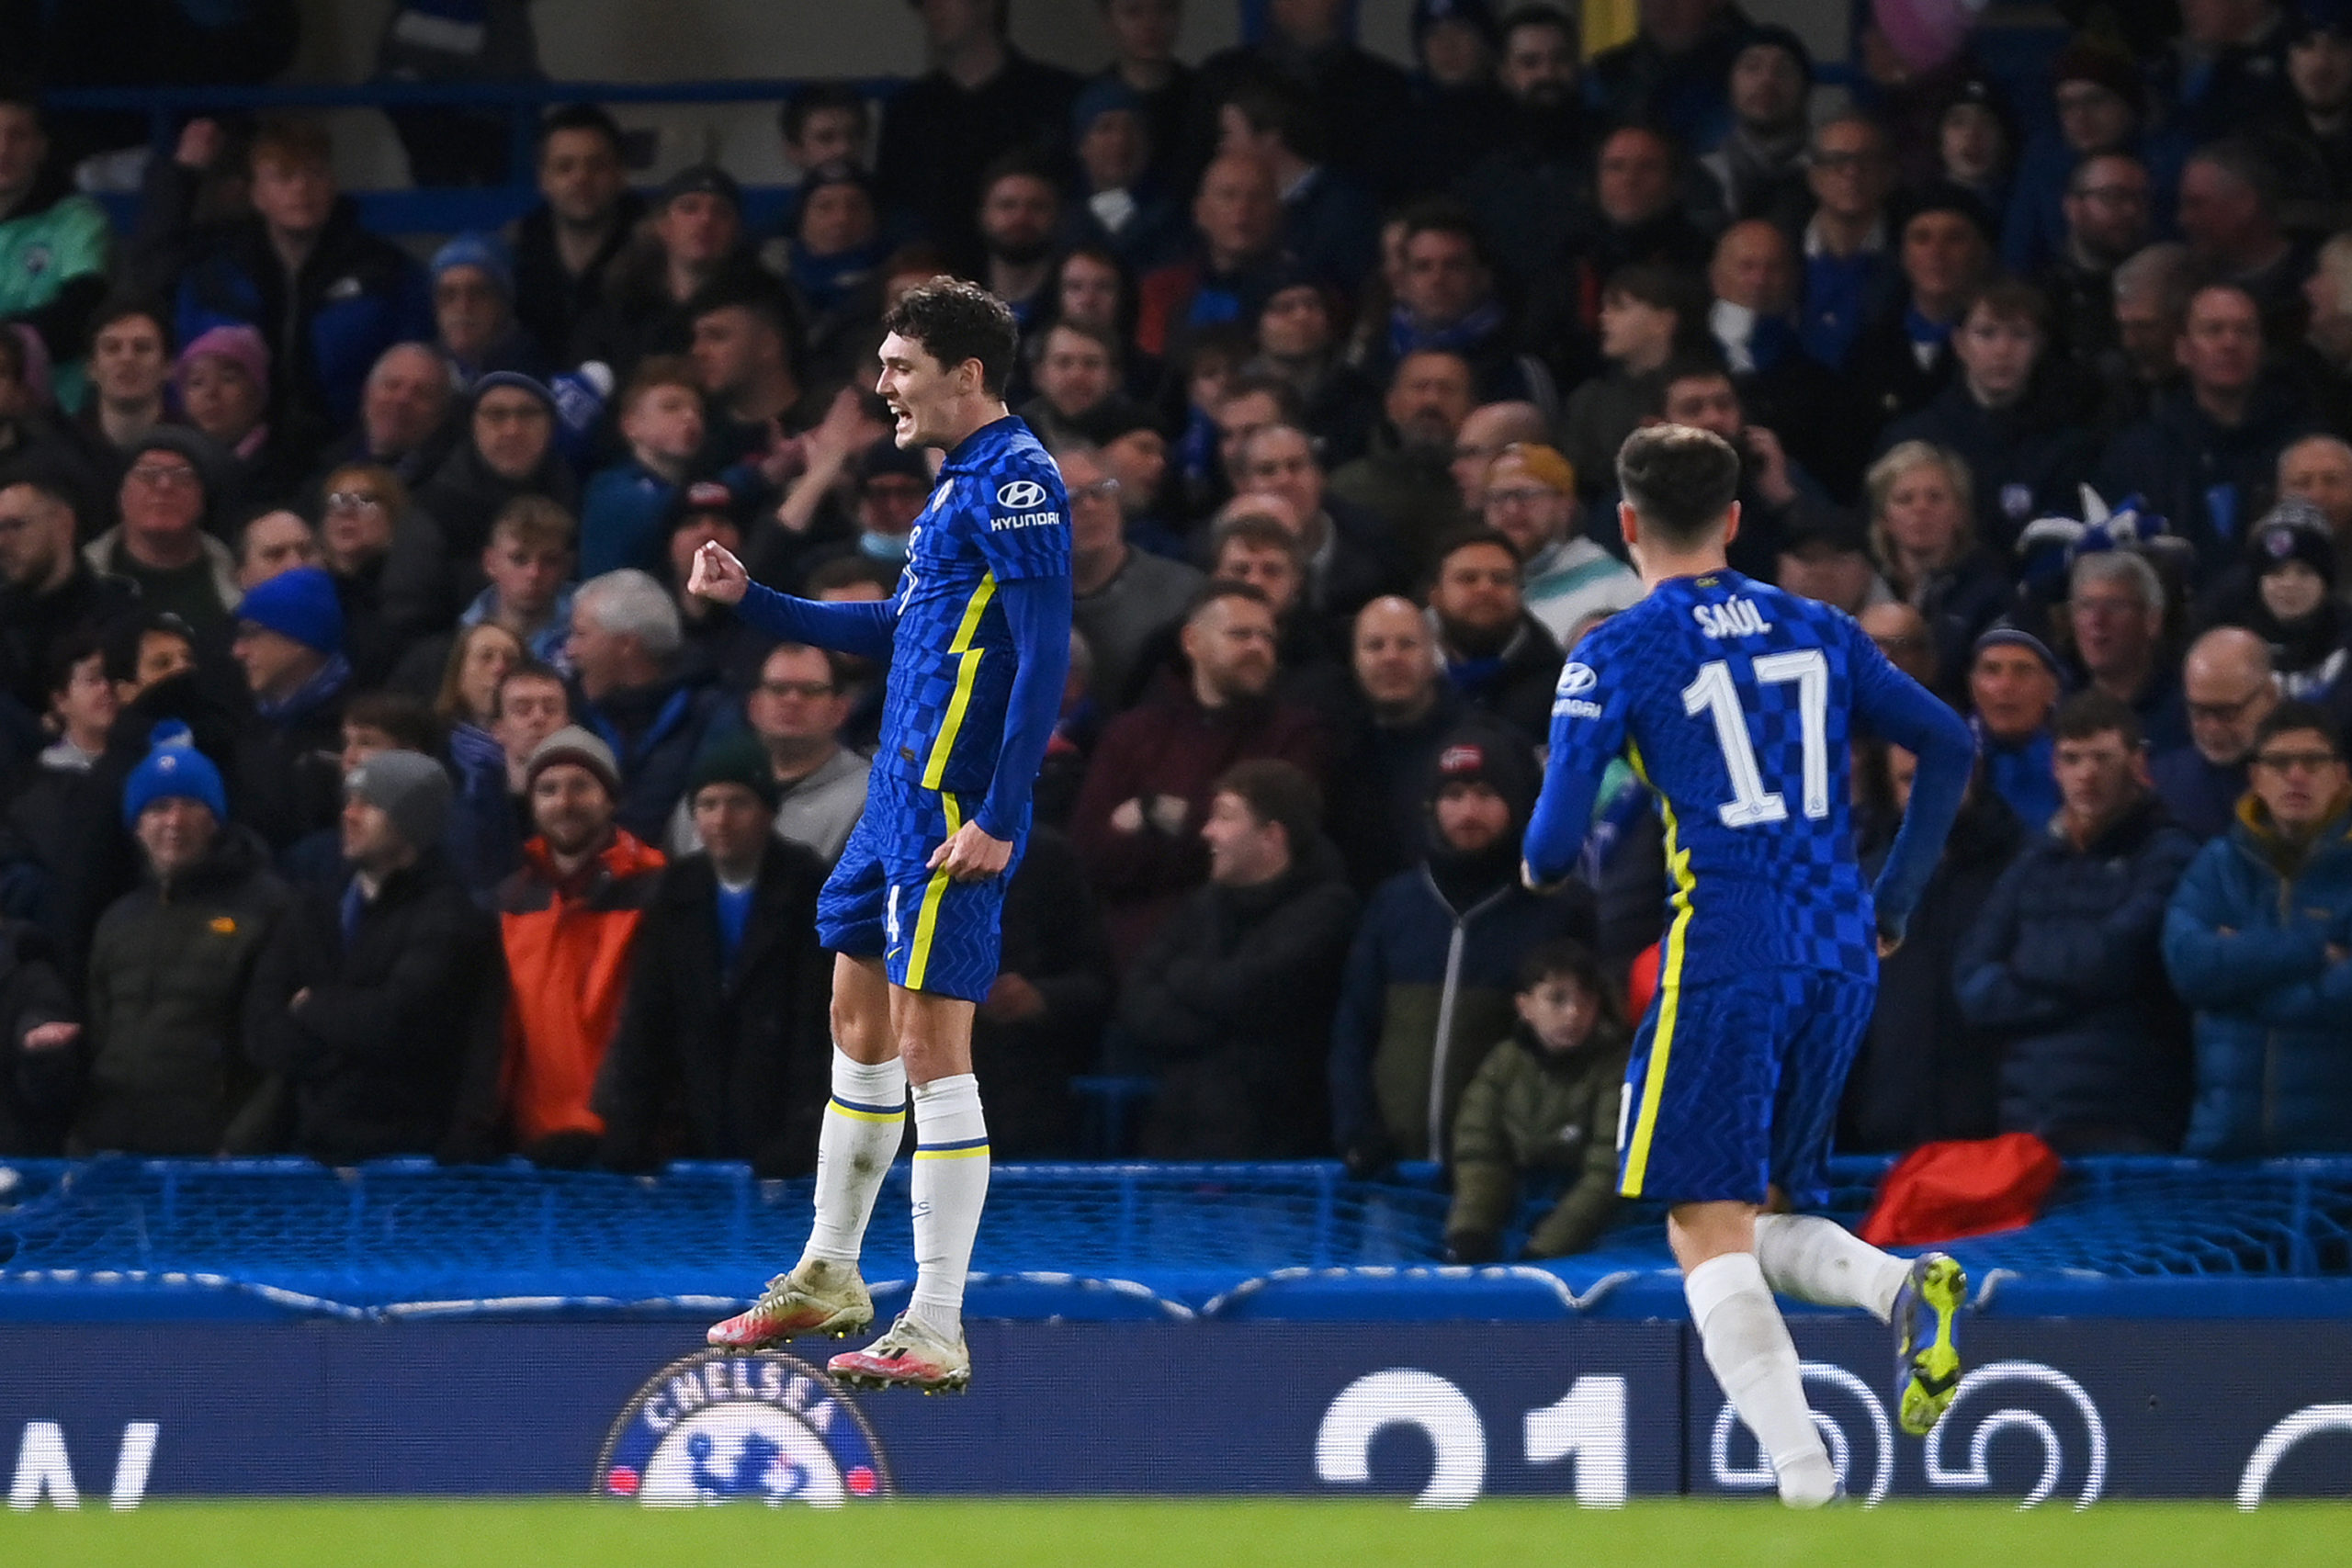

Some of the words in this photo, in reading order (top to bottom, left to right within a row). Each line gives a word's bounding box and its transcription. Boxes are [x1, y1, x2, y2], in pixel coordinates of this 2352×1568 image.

[990, 512, 1059, 532] HYUNDAI
[1692, 594, 1772, 639] SAÚL
[1679, 648, 1829, 828] 17
[643, 1358, 835, 1434] CHELSEA
